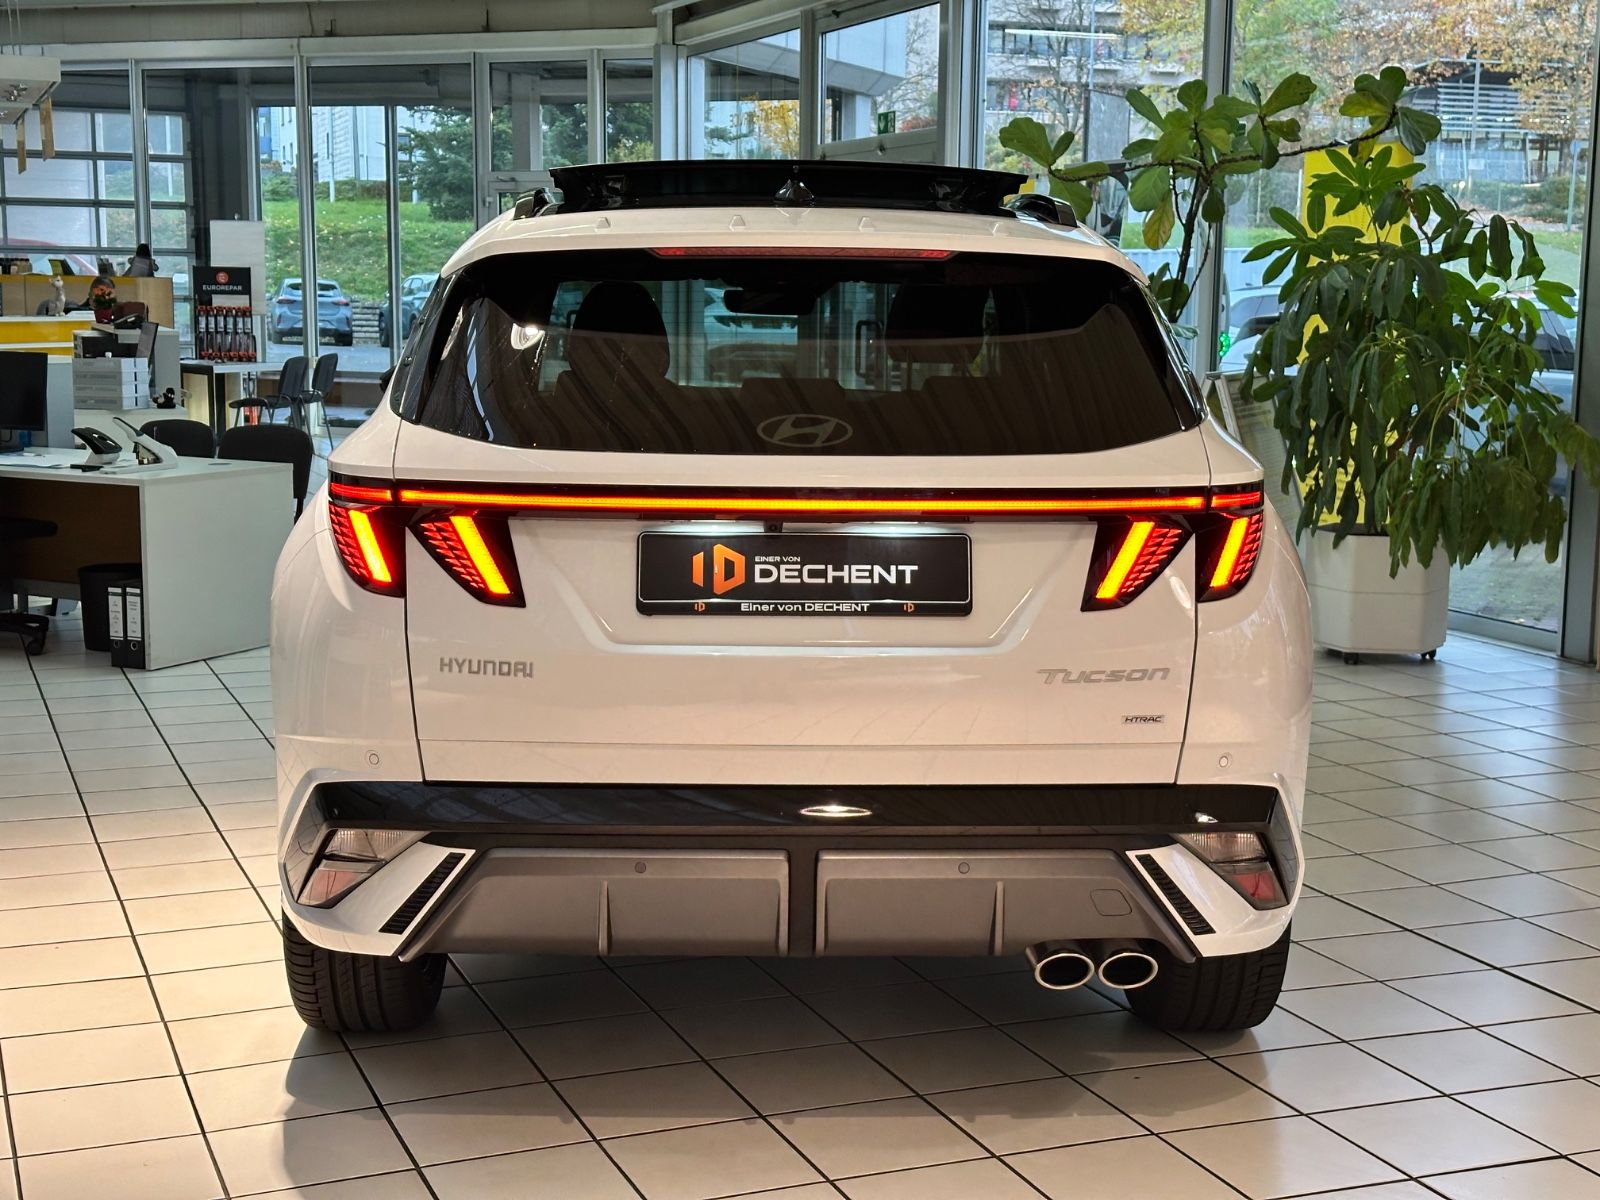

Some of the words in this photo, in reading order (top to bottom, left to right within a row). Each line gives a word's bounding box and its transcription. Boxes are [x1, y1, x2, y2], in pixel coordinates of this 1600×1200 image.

[754, 564, 918, 583] DECHENT
[740, 602, 775, 612] Einer
[777, 604, 802, 612] von
[804, 603, 870, 612] DECHENT
[439, 657, 534, 678] HYUNDAI
[1124, 715, 1162, 723] HTRAC
